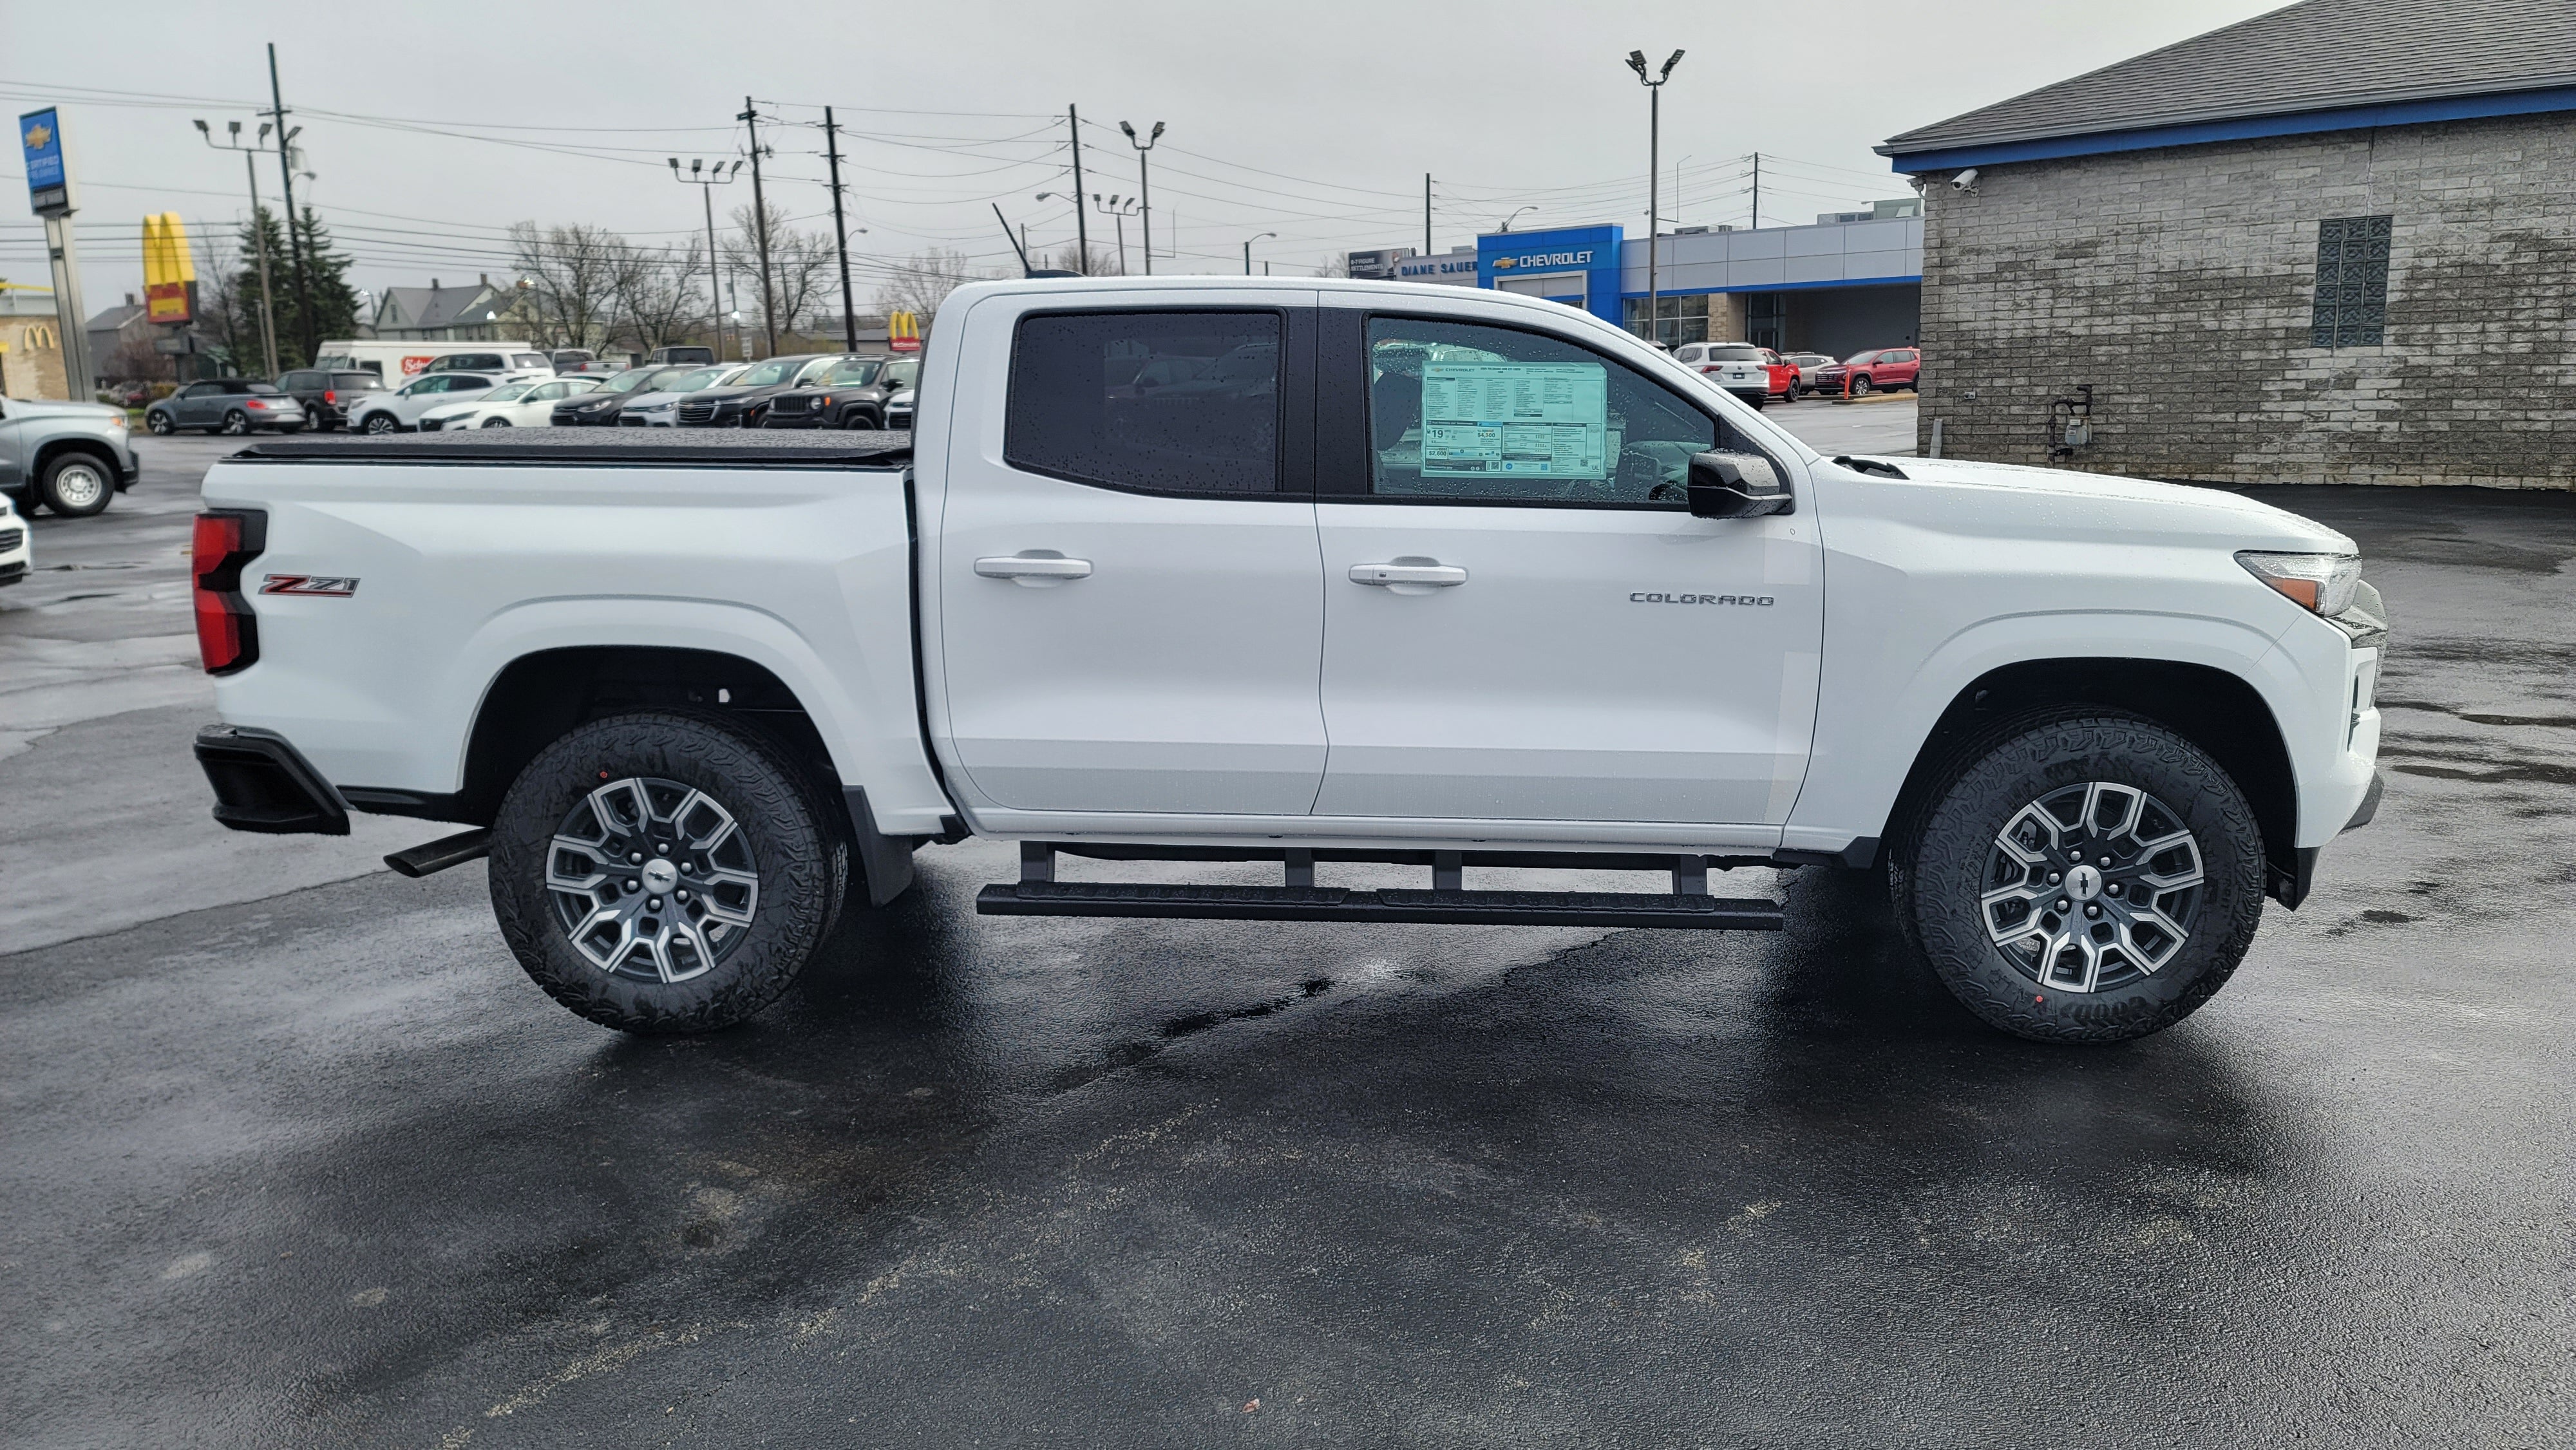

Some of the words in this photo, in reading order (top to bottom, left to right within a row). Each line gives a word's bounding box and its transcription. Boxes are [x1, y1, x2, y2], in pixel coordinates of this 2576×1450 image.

[1520, 250, 1594, 268] CHEVROLET
[1401, 265, 1434, 276] DIANE
[1441, 261, 1478, 274] SAUER
[1432, 429, 1443, 438] 19
[258, 574, 361, 598] Z71
[1630, 592, 1774, 605] COLORADO
